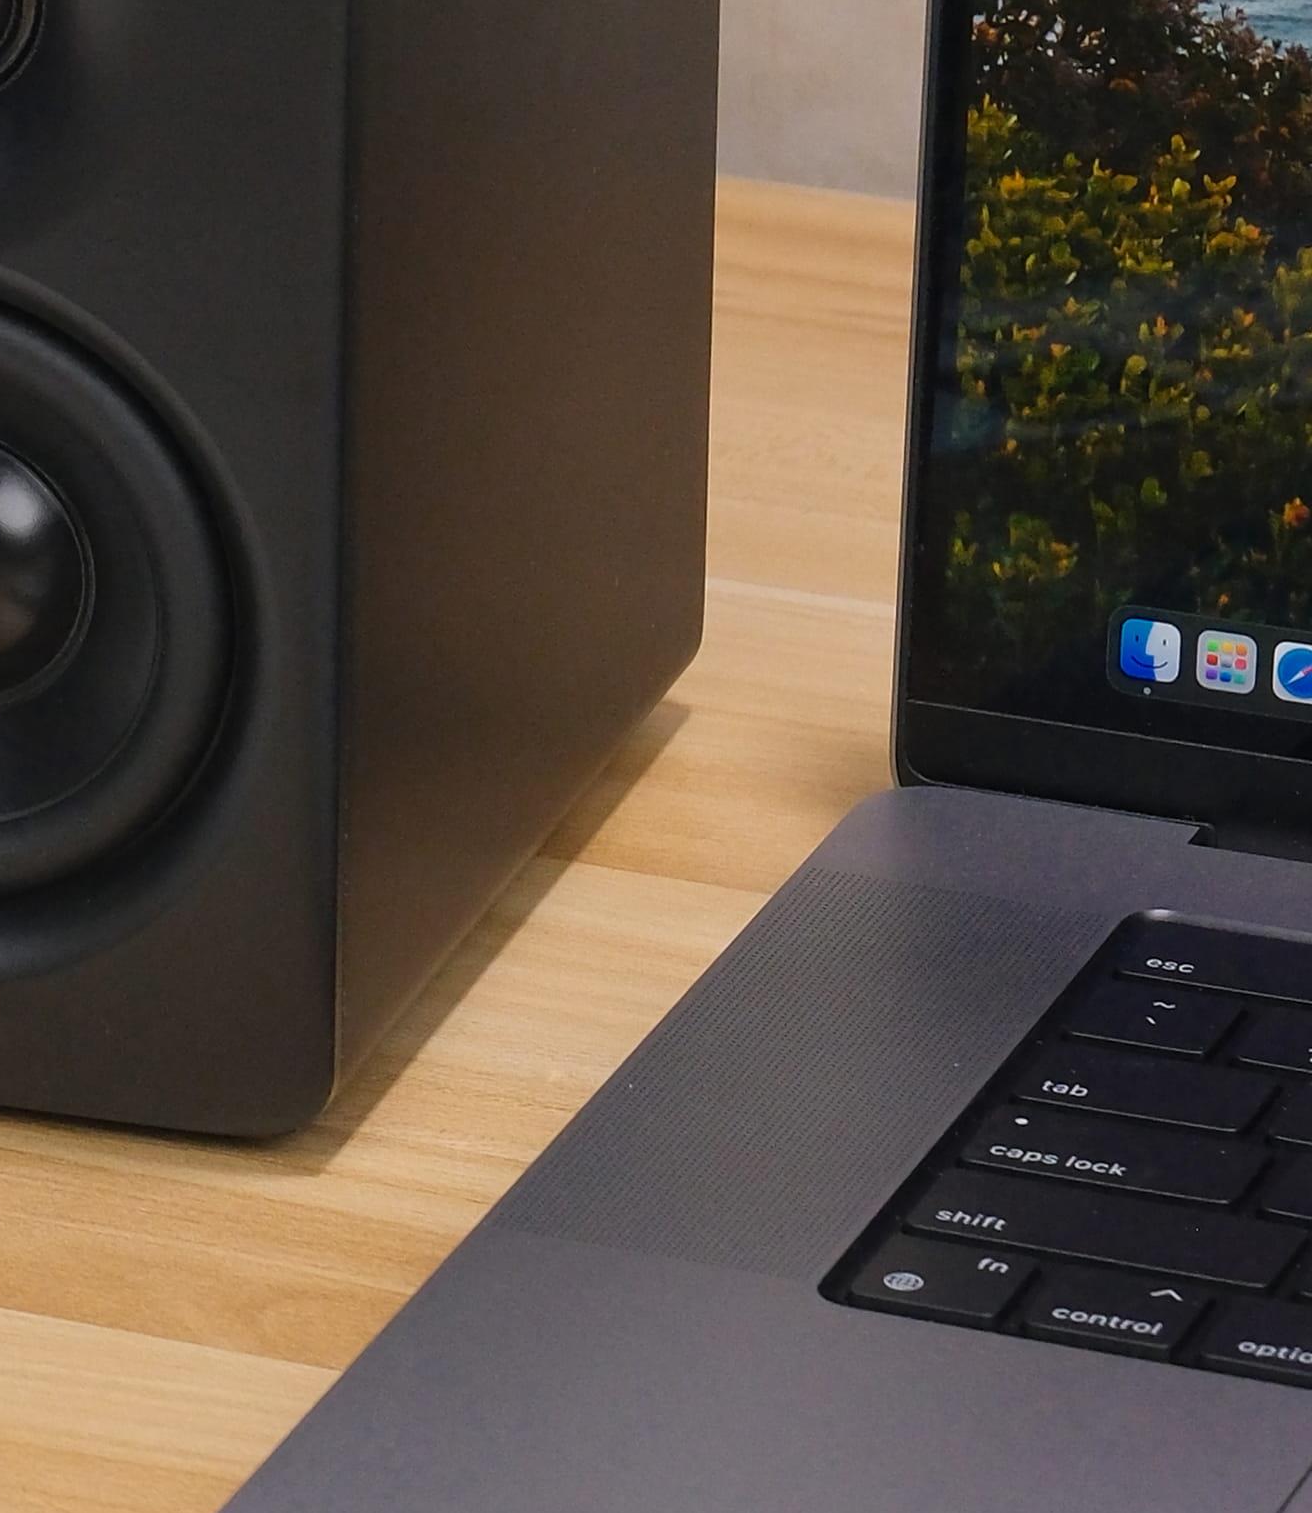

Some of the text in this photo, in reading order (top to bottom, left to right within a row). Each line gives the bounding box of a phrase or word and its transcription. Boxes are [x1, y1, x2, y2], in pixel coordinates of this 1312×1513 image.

[1145, 958, 1195, 974] esc
[1042, 1080, 1089, 1097] tab
[989, 1145, 1127, 1176] caps lock
[935, 1209, 1007, 1231] shift
[977, 1257, 1010, 1274] fn
[1051, 1307, 1163, 1336] control
